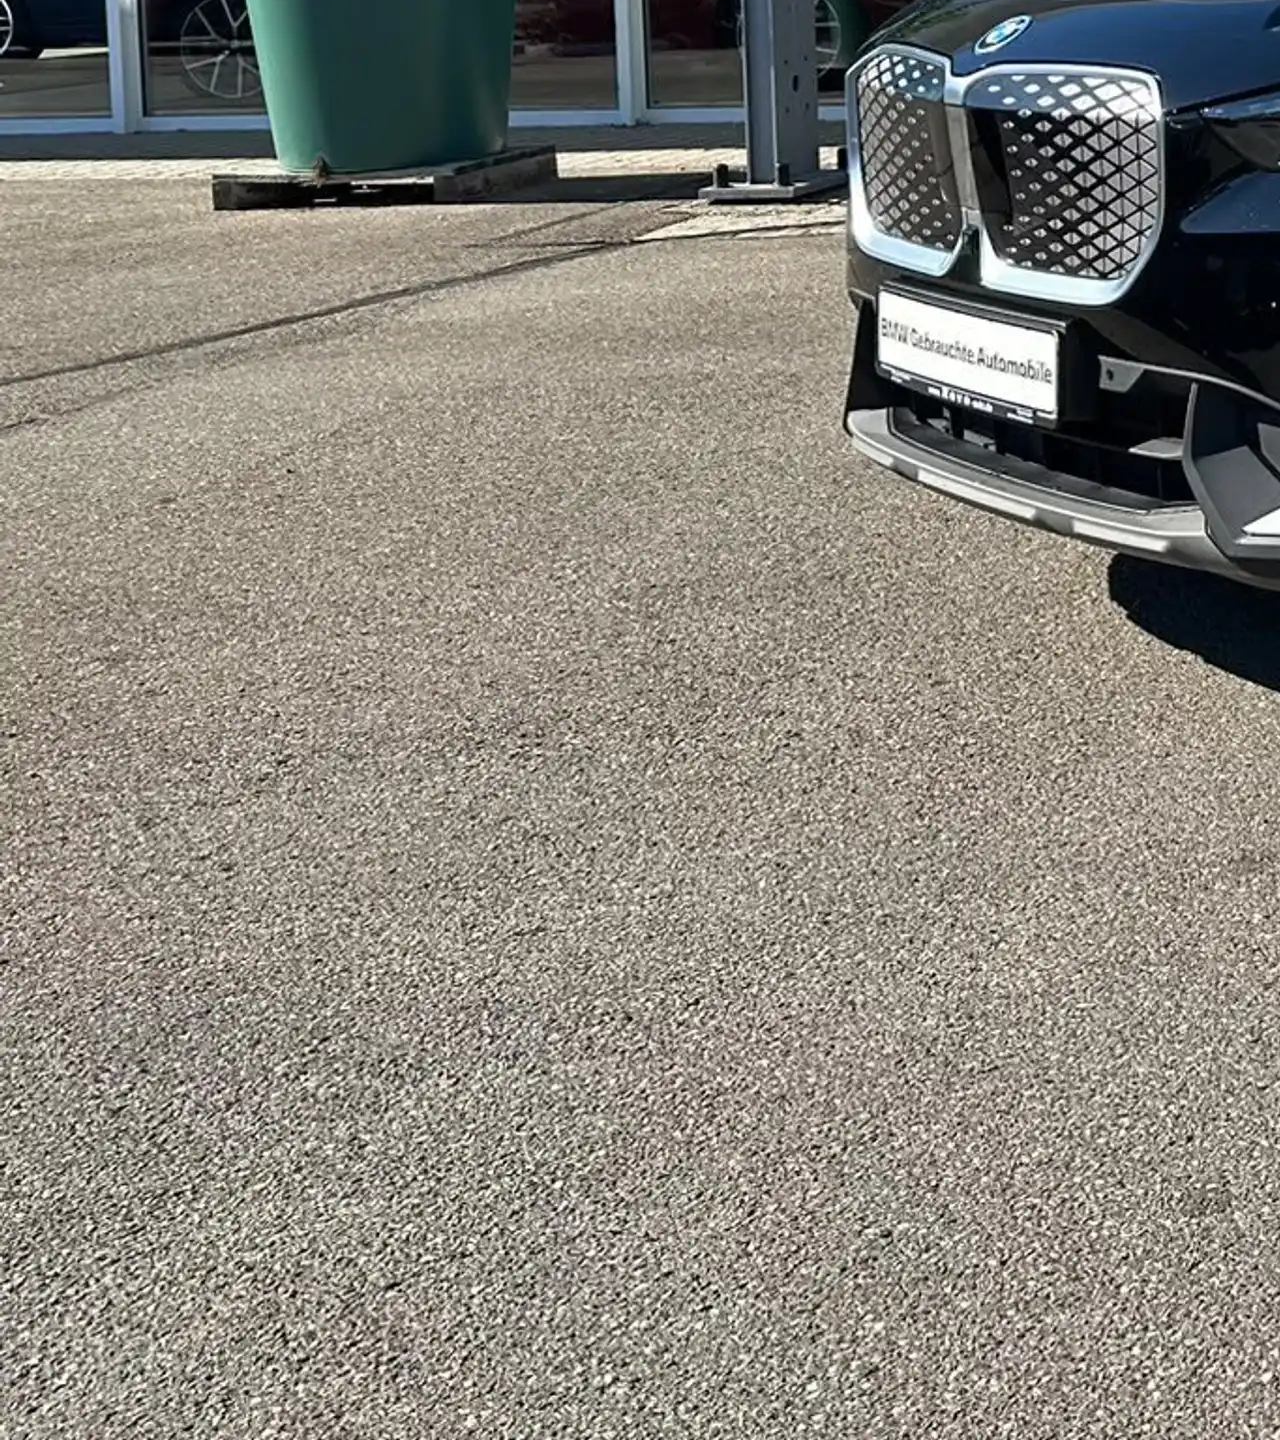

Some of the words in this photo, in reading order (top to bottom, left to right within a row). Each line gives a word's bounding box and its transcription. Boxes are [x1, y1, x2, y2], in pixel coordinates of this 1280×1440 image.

[881, 317, 909, 344] BMW
[910, 327, 975, 365] Gebrauchte
[977, 346, 1053, 385] Automobile
